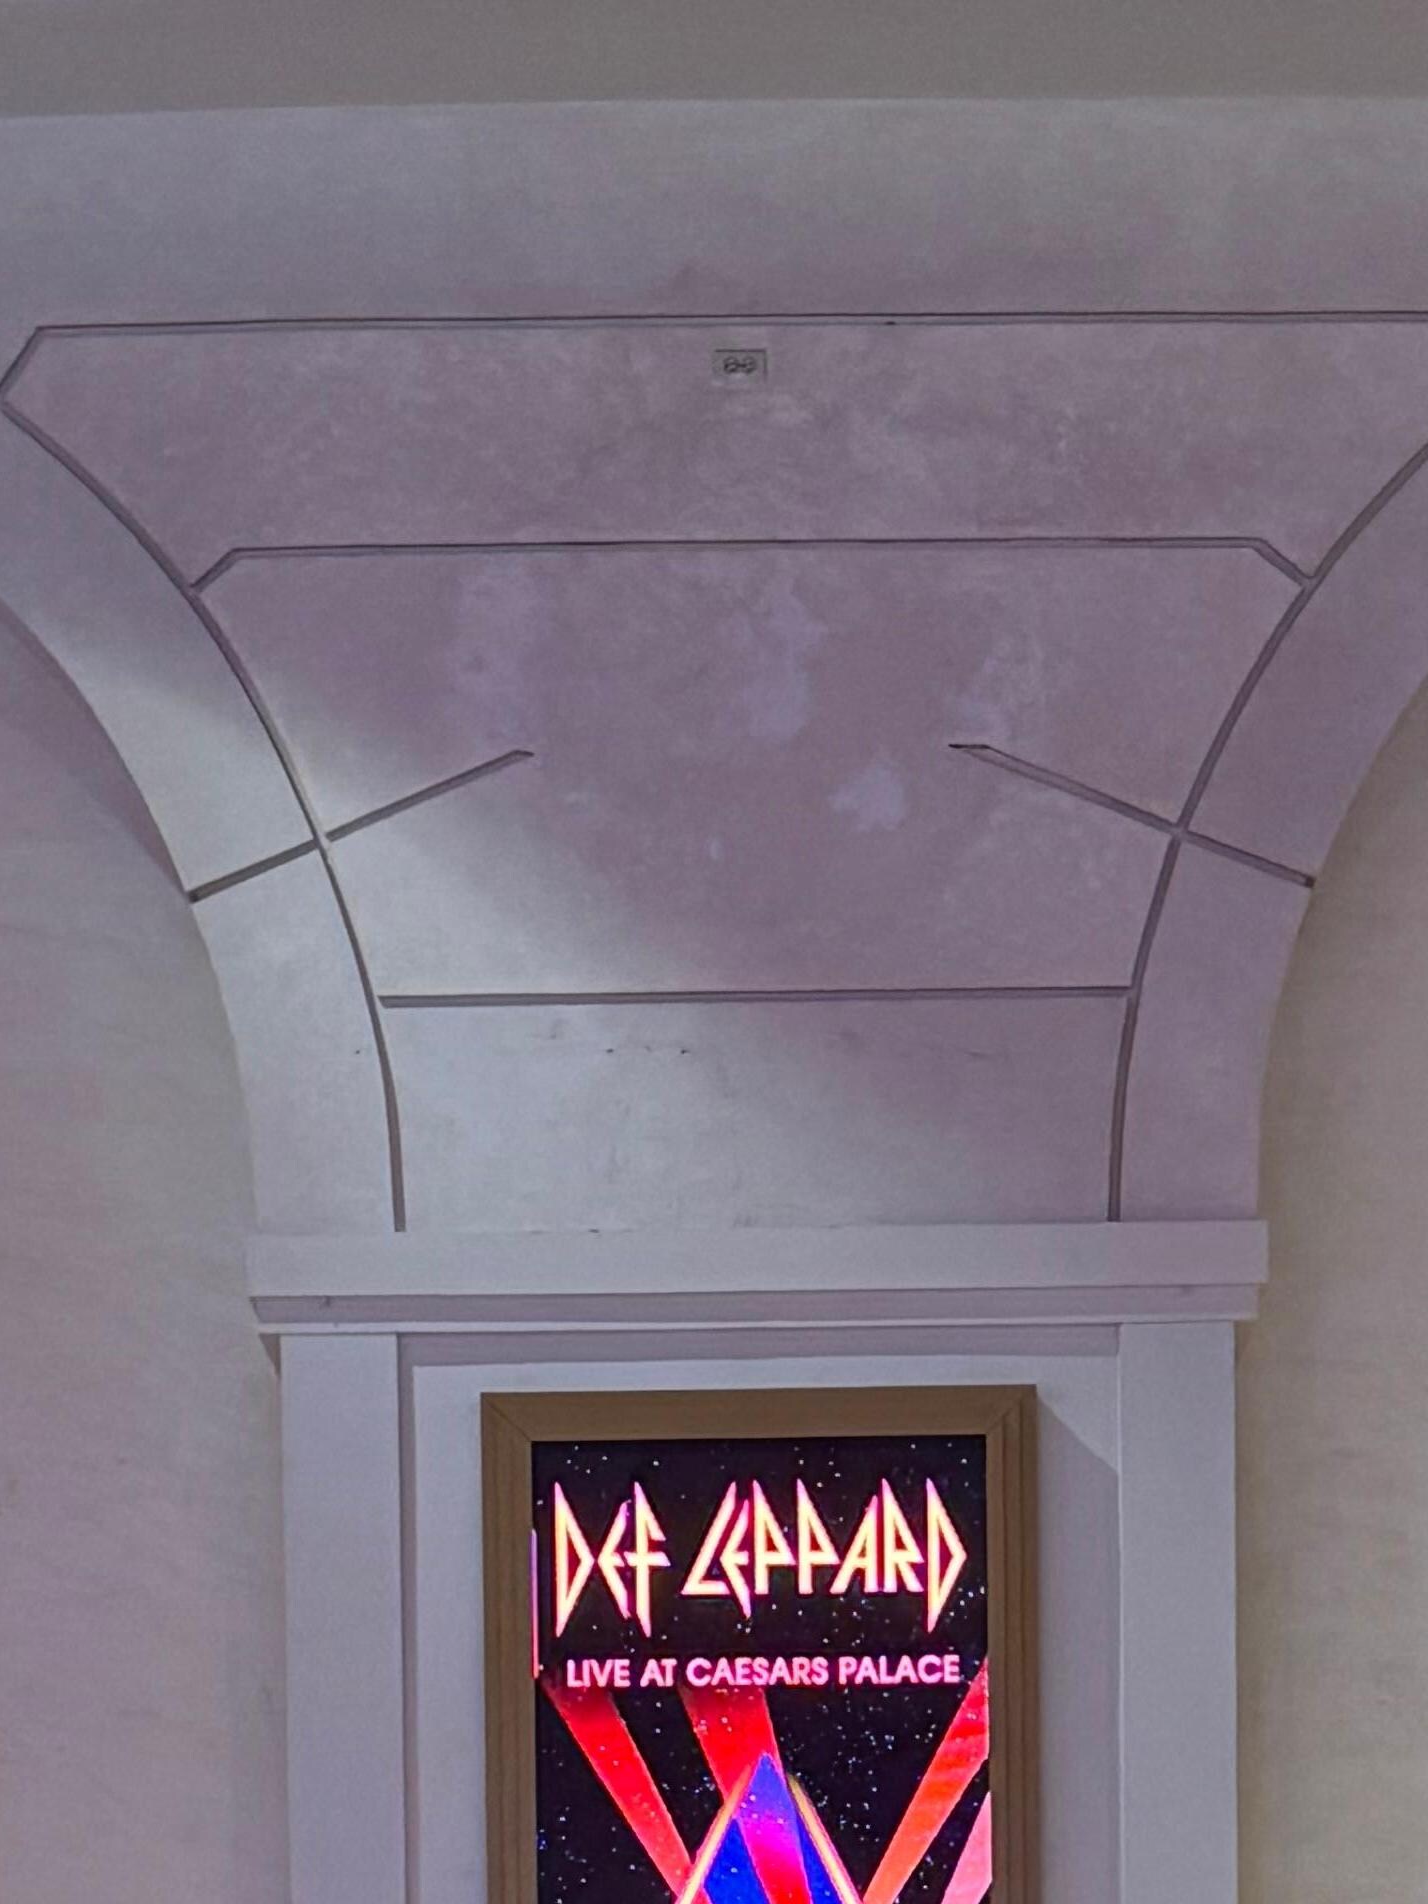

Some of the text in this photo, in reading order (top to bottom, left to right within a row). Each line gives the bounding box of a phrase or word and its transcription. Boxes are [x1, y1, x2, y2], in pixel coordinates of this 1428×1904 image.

[554, 1477, 967, 1637] DEF LEPPARD
[567, 1655, 960, 1688] LIVE AT CAESARS PALACE
